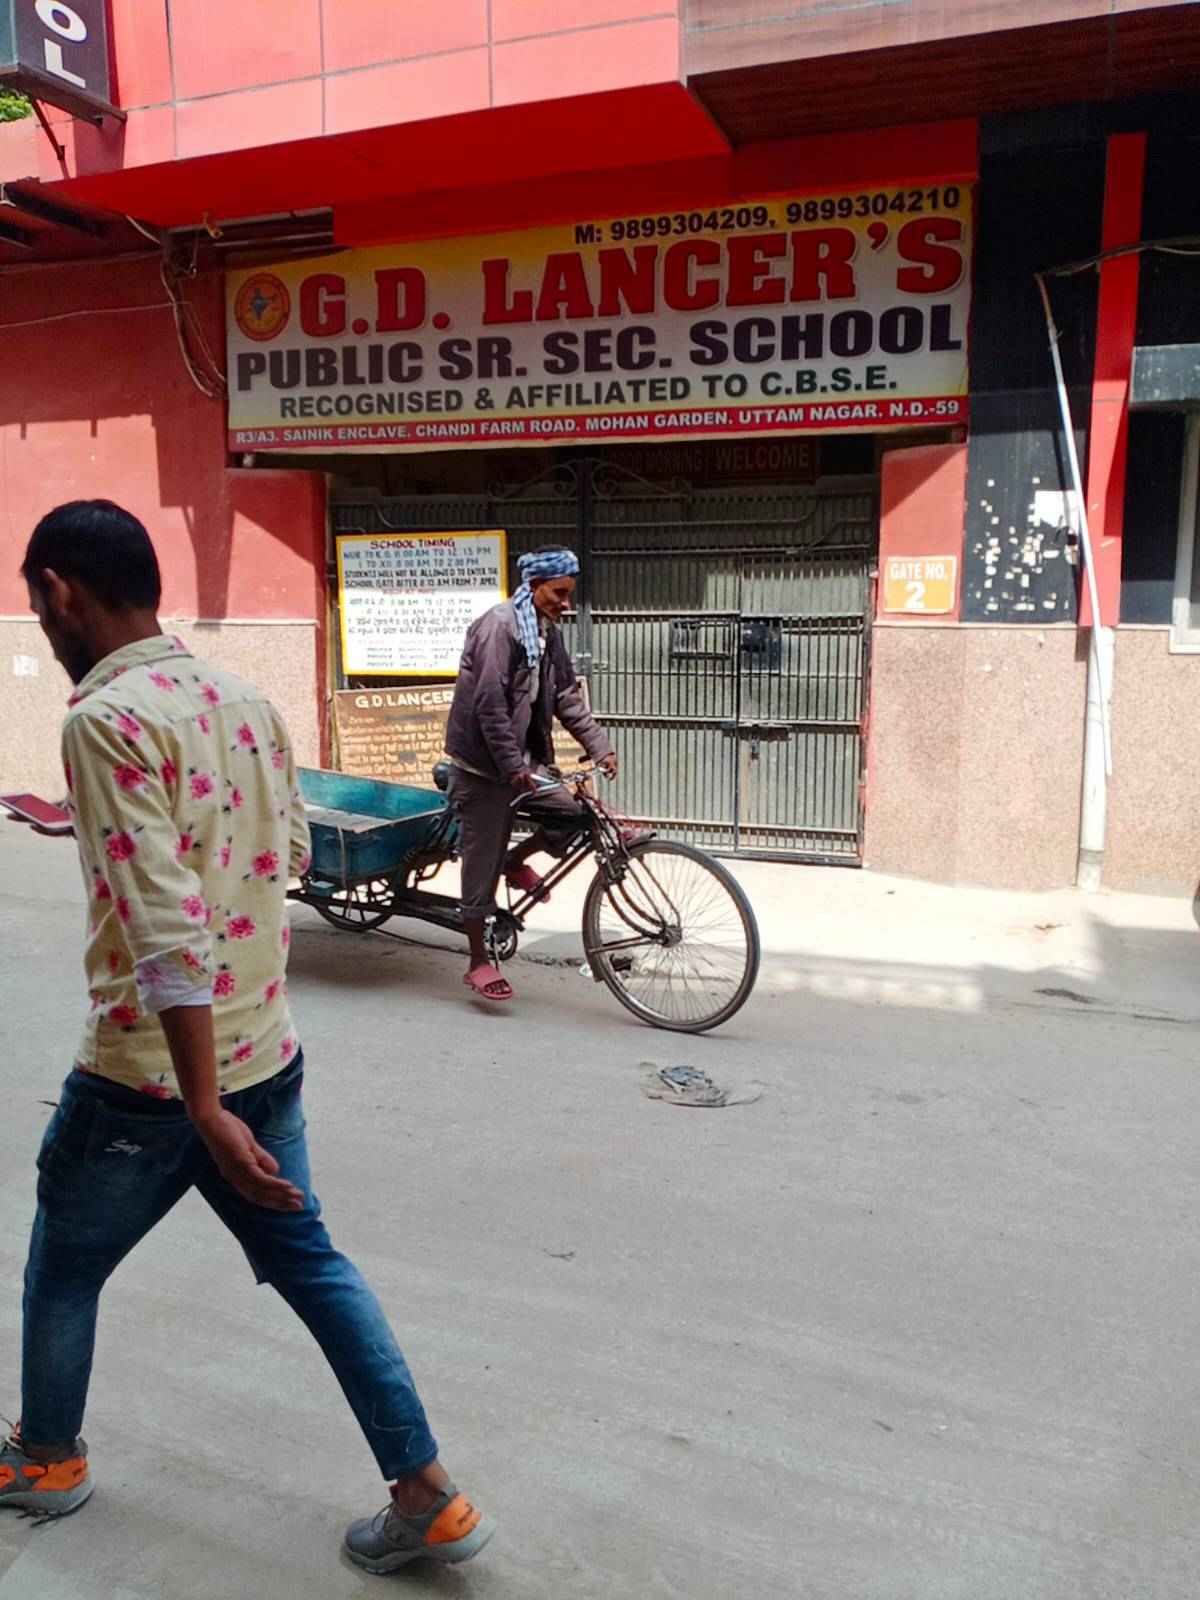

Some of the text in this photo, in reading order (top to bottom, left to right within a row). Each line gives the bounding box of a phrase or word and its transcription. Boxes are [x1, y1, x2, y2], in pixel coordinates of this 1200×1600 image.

[575, 224, 603, 244] M:
[786, 186, 961, 224] 9899304210
[299, 216, 963, 338] G.D. LANCER'S
[237, 303, 962, 391] PUBLIC SR. SEC. SCHOOL
[280, 364, 898, 418] RECOGNISED & AFFILIATED TO C.B.S.E.
[283, 428, 333, 442] SAINIK
[415, 421, 476, 437] CHANDI
[481, 419, 525, 435] FARM
[586, 414, 649, 431] MOHAN
[738, 407, 804, 424] UTTAM
[714, 443, 810, 471] WELCOME
[370, 538, 456, 550] SCHOOL TIMING
[903, 581, 926, 609] 2
